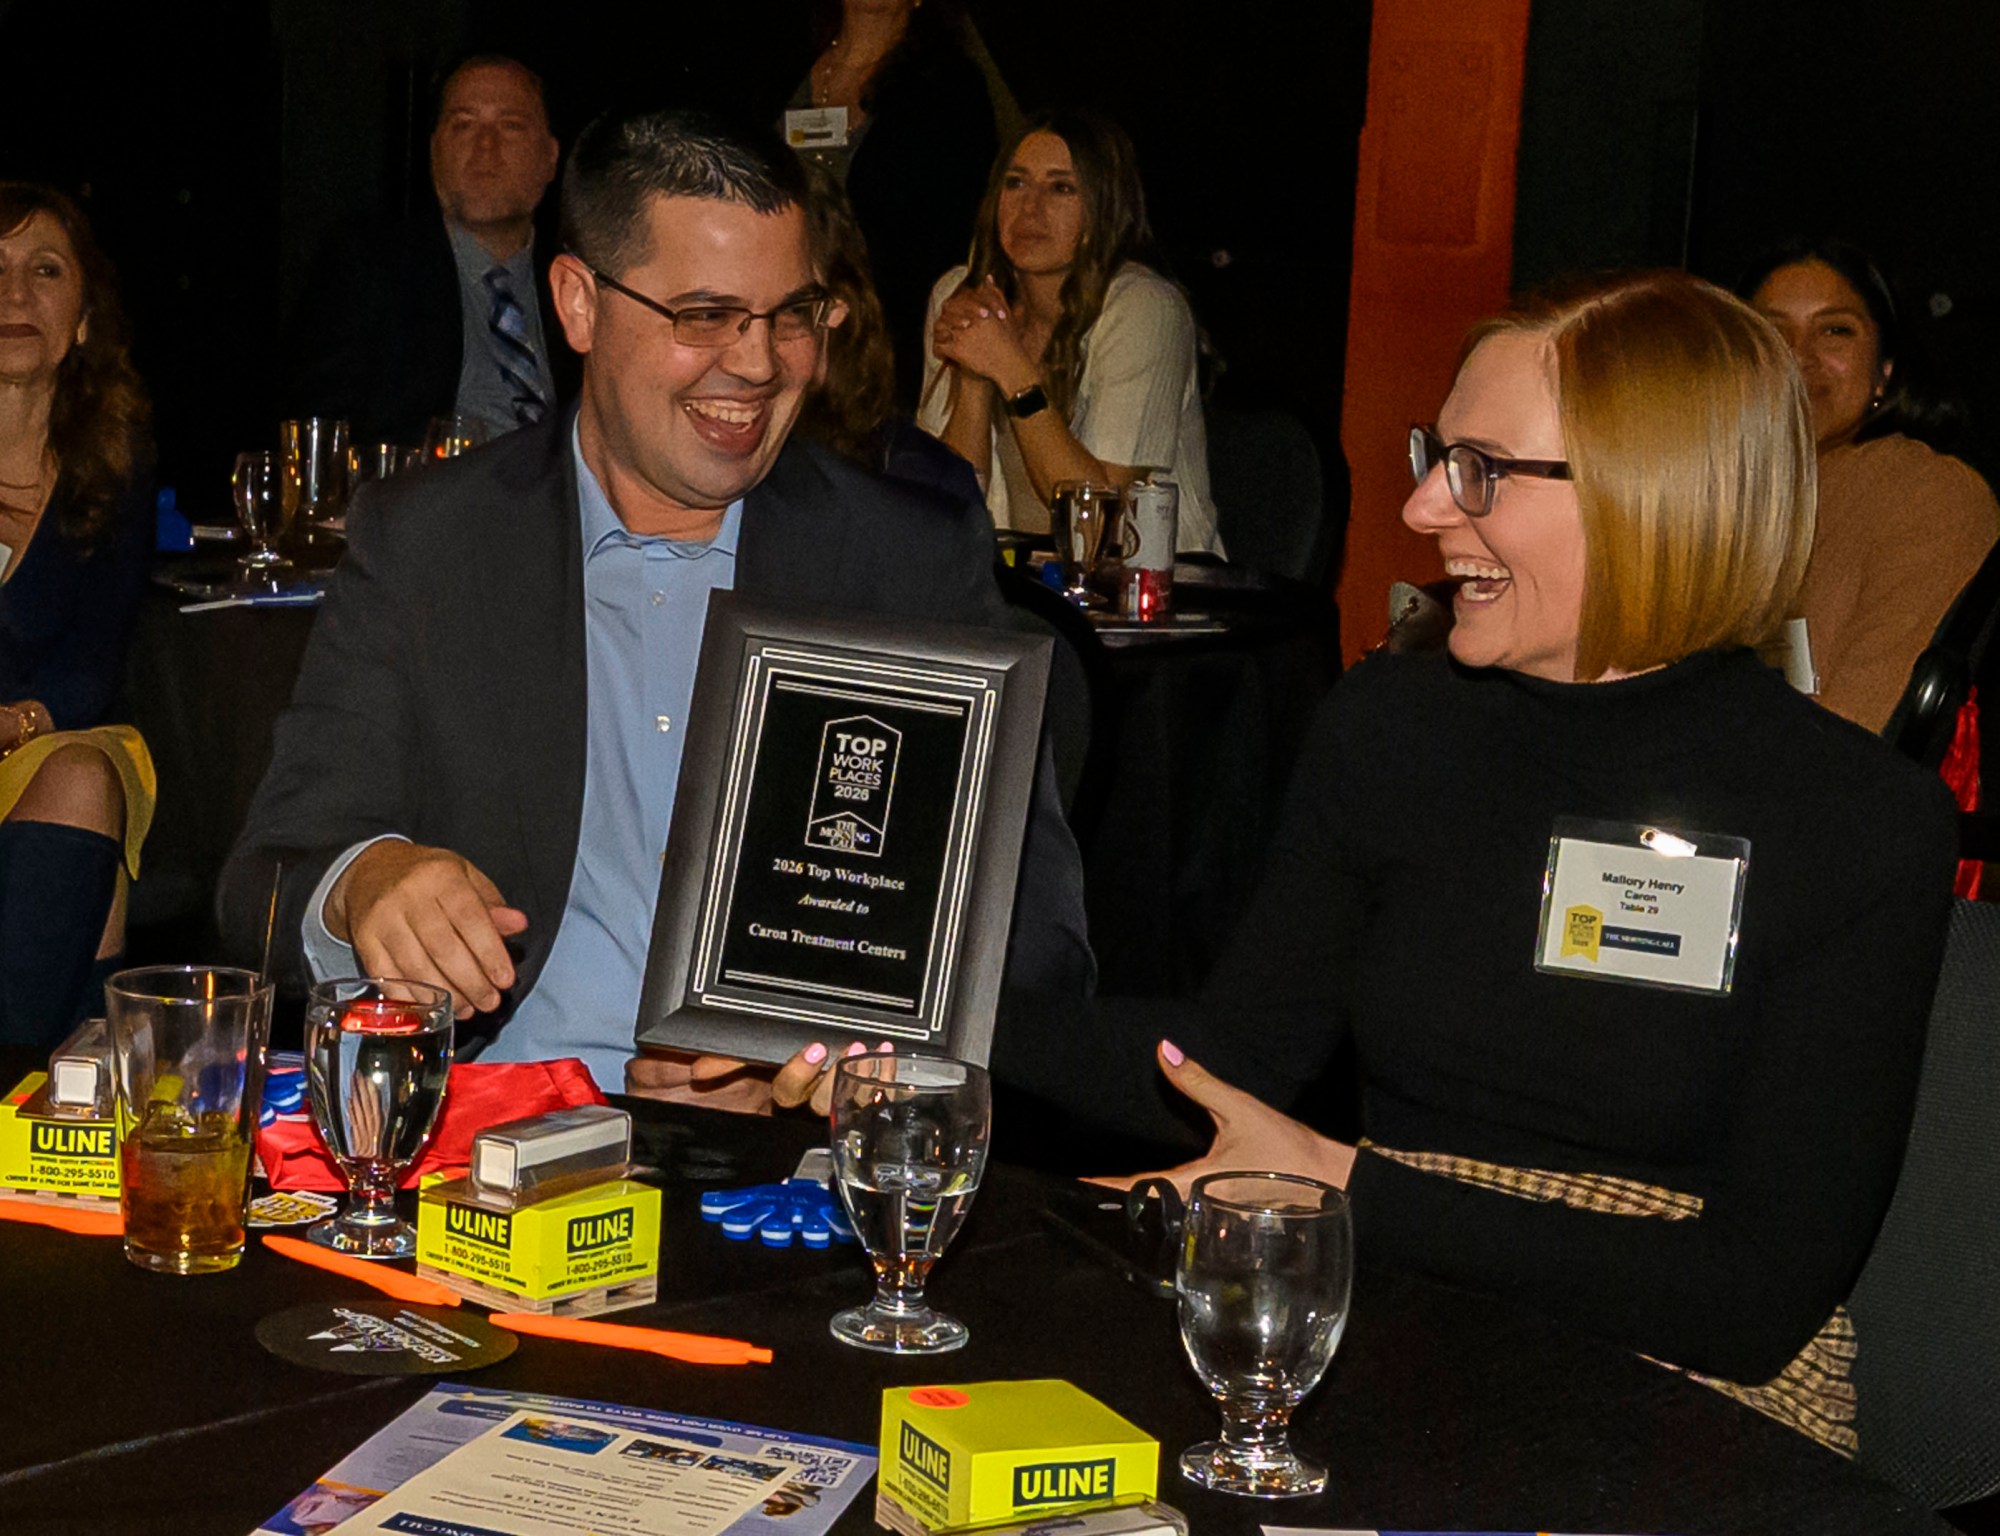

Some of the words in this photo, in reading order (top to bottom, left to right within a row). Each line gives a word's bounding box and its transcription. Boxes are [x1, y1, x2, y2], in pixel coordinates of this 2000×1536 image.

[836, 733, 887, 757] TOP
[833, 753, 884, 773] WORK
[829, 767, 882, 786] PLACES
[834, 785, 870, 801] 2026
[773, 858, 803, 874] 2026
[806, 863, 831, 882] Top
[835, 868, 905, 890] Workplace
[1602, 872, 1645, 889] Mallory
[1648, 879, 1685, 894] Henry
[798, 894, 856, 914] Awarded
[856, 903, 869, 915] to
[1624, 890, 1657, 902] Caron
[1571, 913, 1597, 924] TOP
[1619, 901, 1645, 913] Table
[1647, 905, 1659, 915] 29
[749, 923, 787, 941] Caron
[791, 929, 855, 952] Treatment
[857, 940, 906, 960] Centers
[37, 1126, 112, 1154] ULINE
[30, 1164, 116, 1180] 1-800-295-5510
[450, 1206, 509, 1244] ULINE
[572, 1213, 630, 1247] ULINE
[903, 1427, 948, 1485] ULINE
[1020, 1465, 1109, 1500] ULINE
